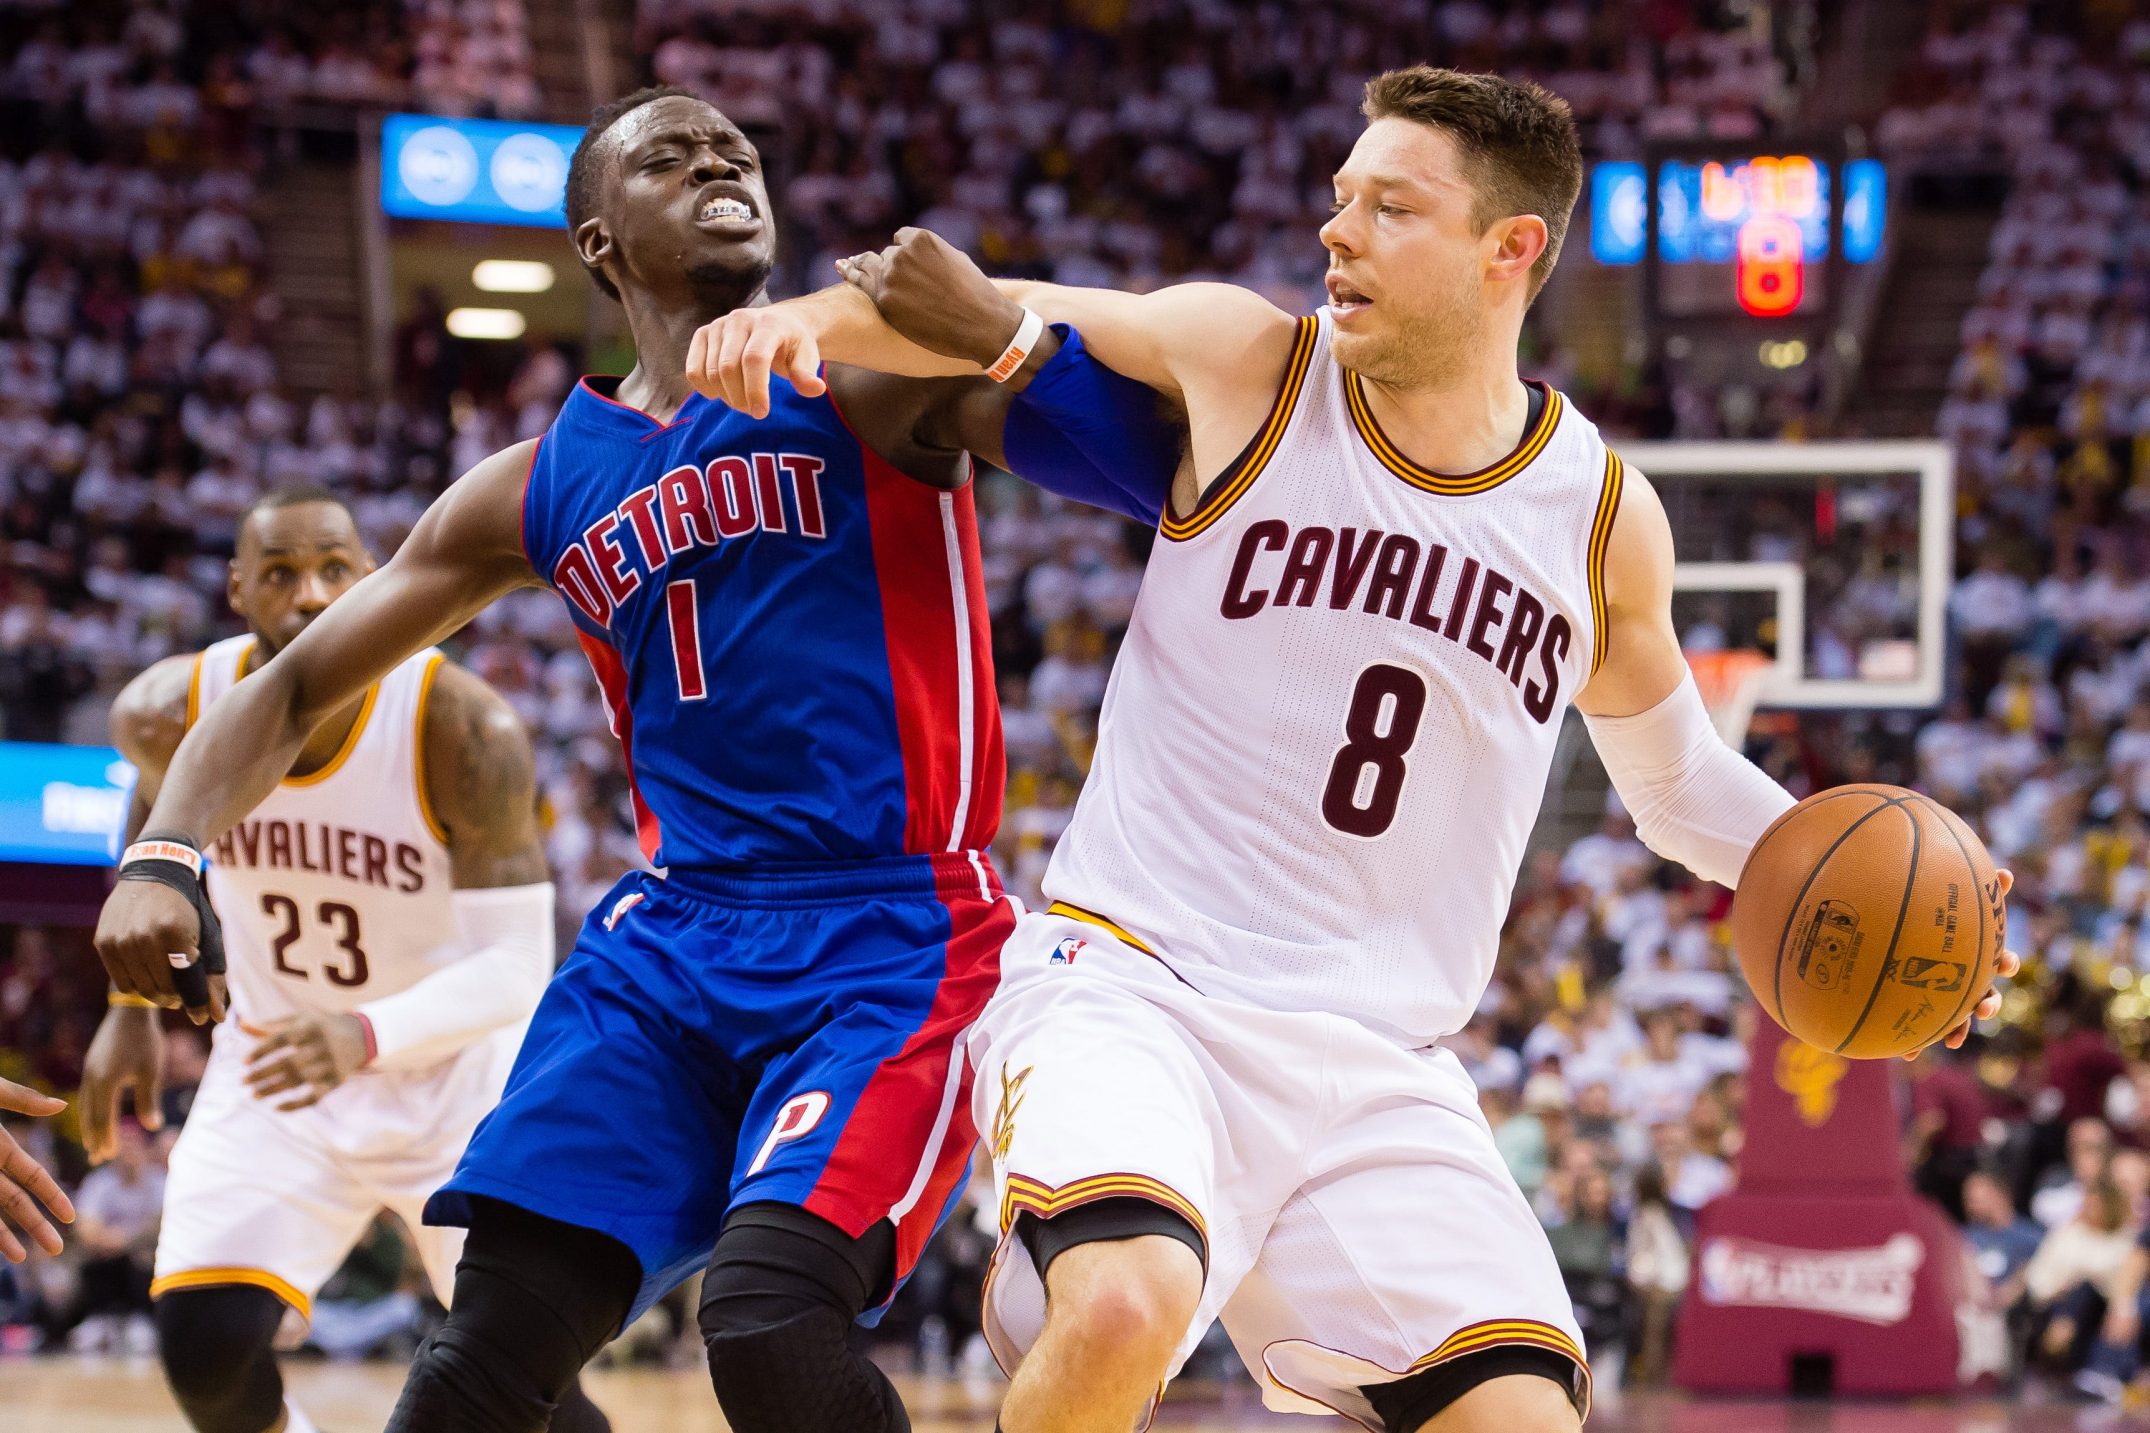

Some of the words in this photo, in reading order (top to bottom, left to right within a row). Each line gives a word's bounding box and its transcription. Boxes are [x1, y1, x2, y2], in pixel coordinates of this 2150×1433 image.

[554, 452, 827, 630] DETROIT
[666, 578, 708, 701] 1
[1220, 519, 1572, 725] CAVALIERS
[1319, 658, 1432, 842] 8
[214, 820, 424, 894] AVALIERS
[261, 894, 369, 987] 23
